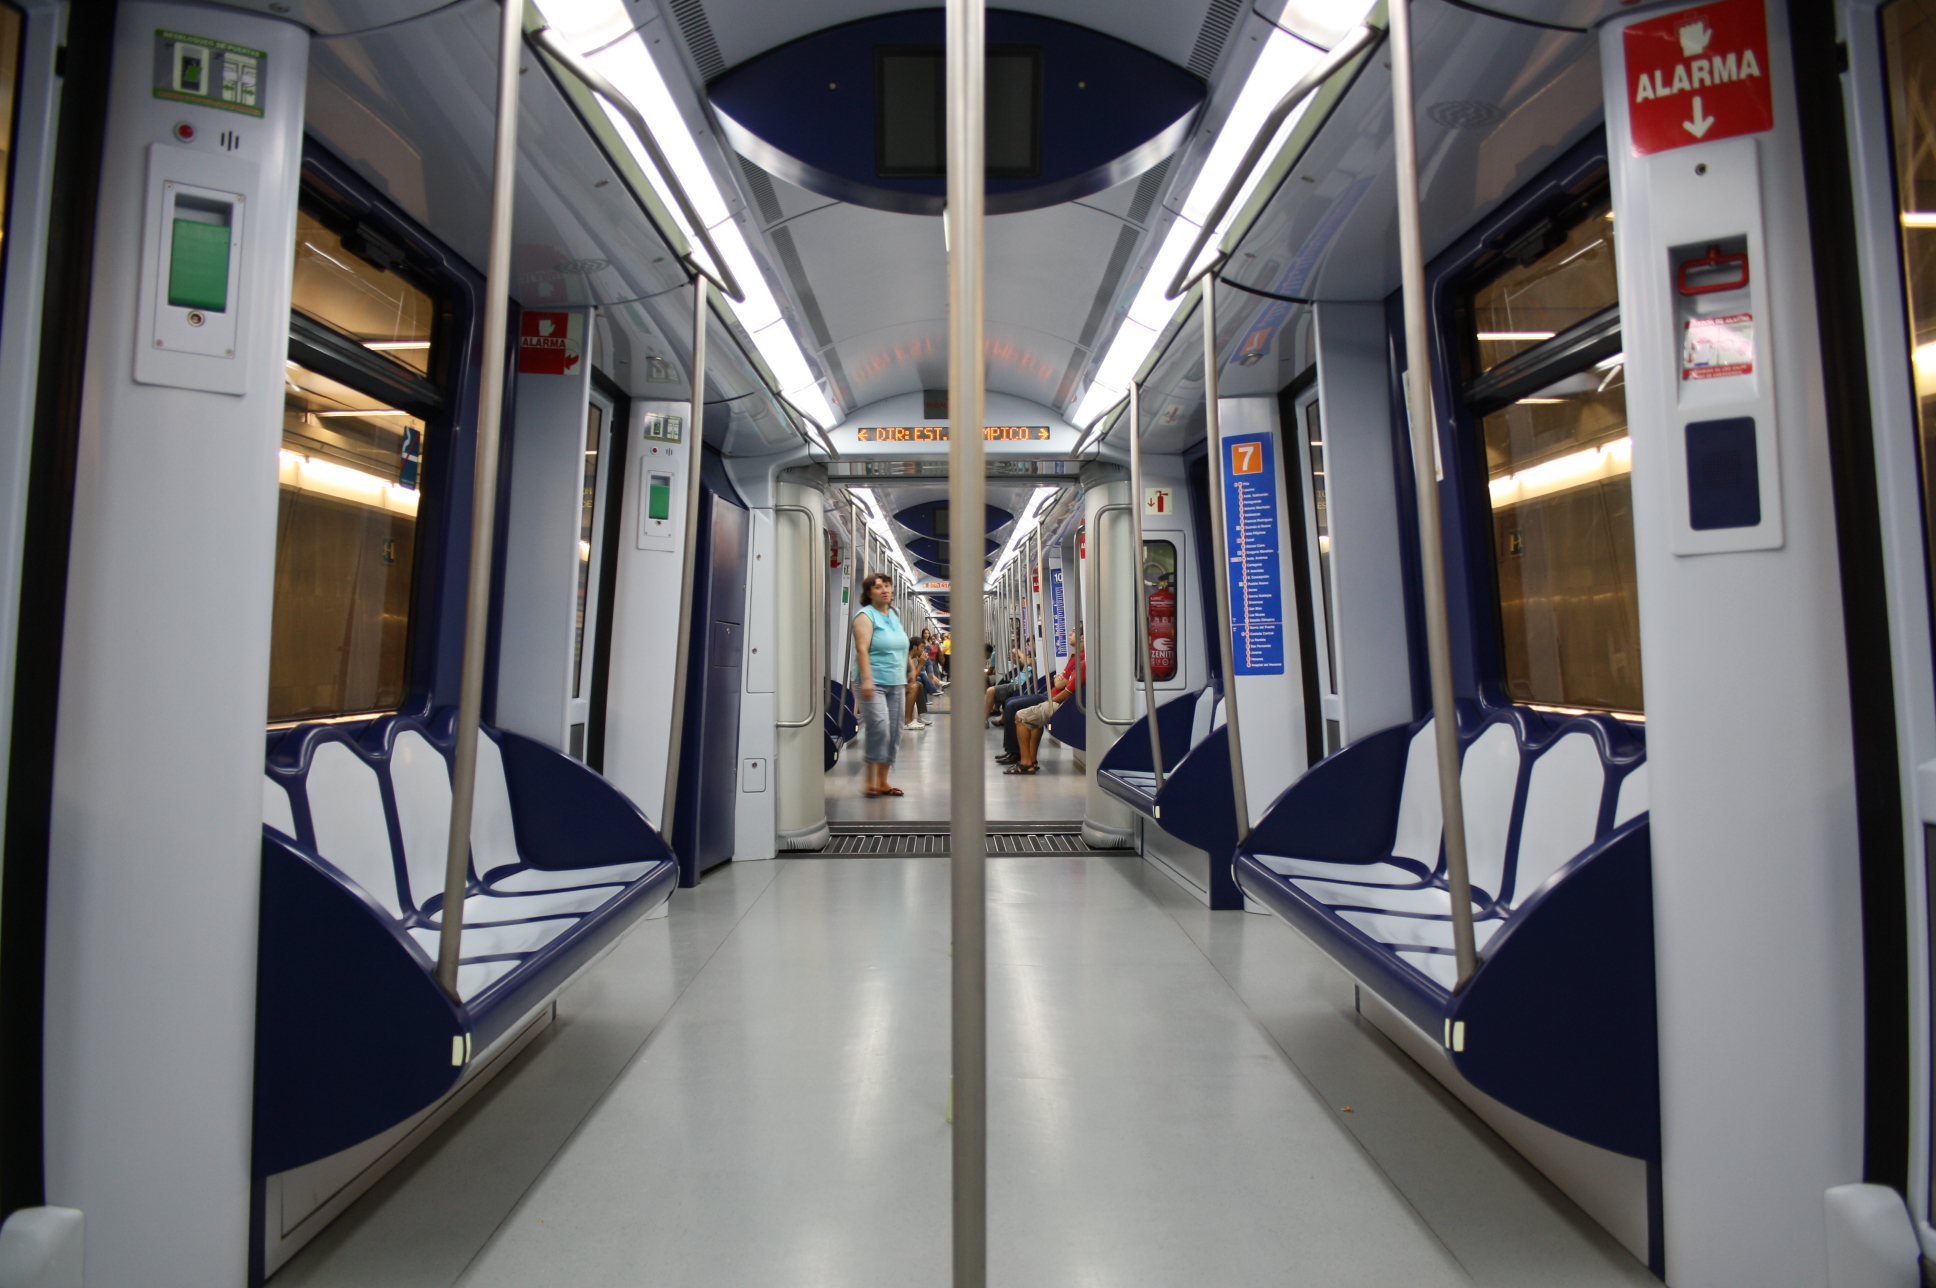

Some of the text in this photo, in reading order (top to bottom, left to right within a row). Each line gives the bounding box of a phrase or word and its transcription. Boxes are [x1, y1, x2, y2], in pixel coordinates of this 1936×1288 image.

[1636, 49, 1761, 103] ALARMA
[522, 337, 566, 348] ALARMA
[876, 427, 1030, 442] DIR: EST. MPICO
[1238, 446, 1254, 471] 7
[1054, 572, 1063, 582] 10
